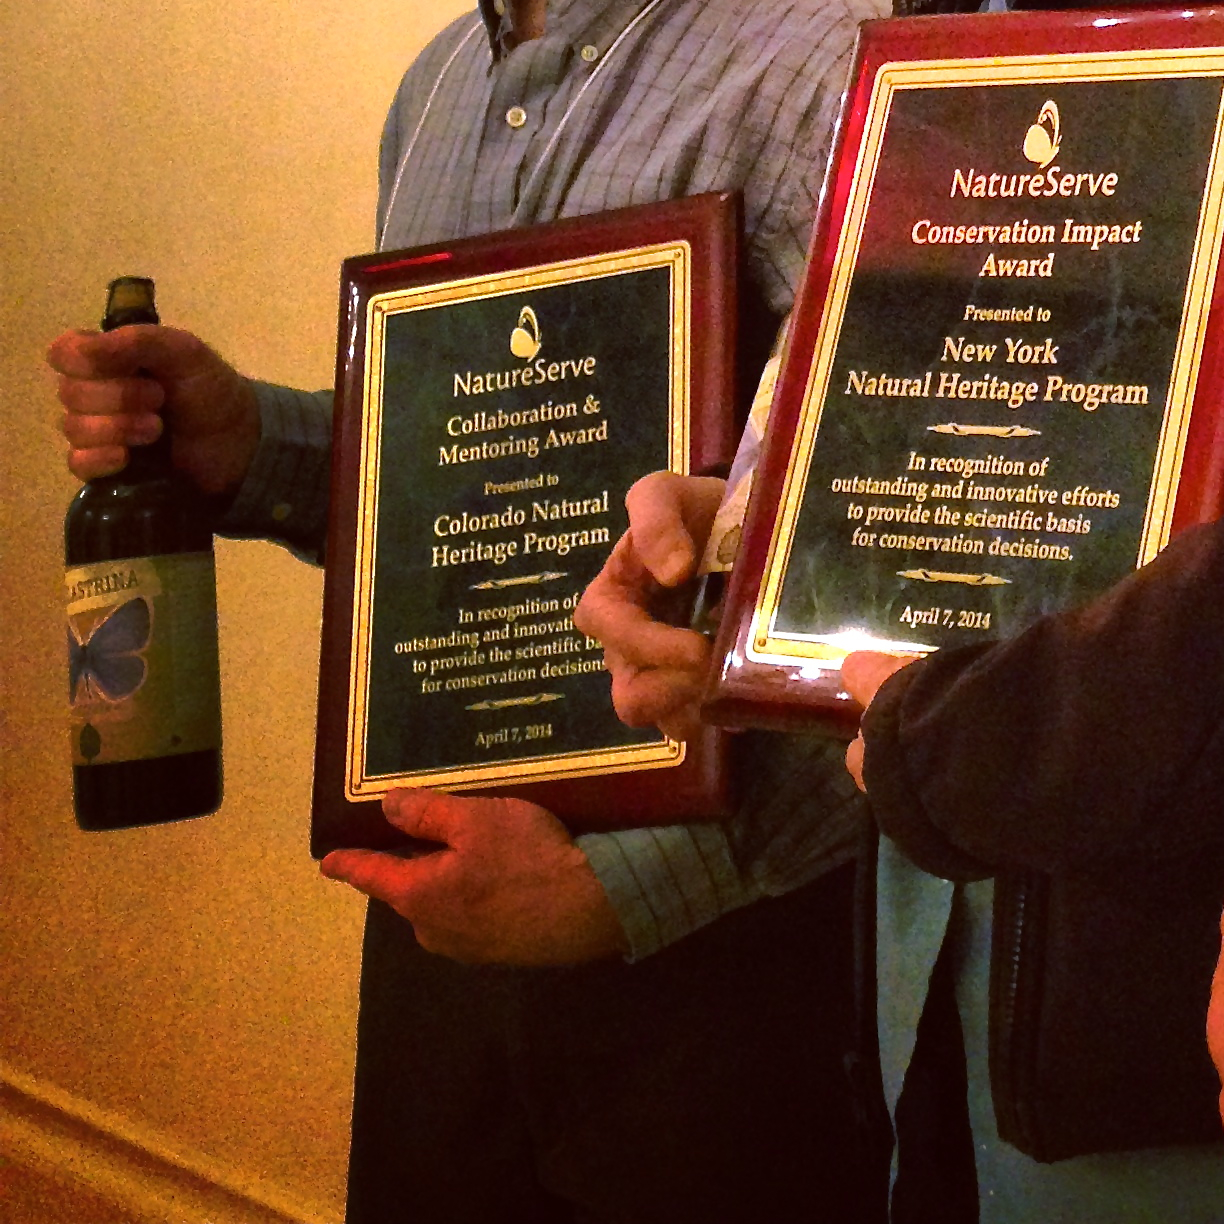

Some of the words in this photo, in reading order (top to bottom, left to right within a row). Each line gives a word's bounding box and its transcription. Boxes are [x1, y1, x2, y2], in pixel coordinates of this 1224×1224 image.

[950, 166, 1118, 198] NatureServe
[911, 219, 1055, 244] Conservation
[1060, 219, 1142, 250] Impact
[979, 253, 1054, 277] Award
[963, 305, 1033, 322] Presented
[1037, 307, 1051, 322] to
[941, 337, 997, 362] New
[1005, 338, 1059, 364] York
[453, 356, 596, 397] NatureServe
[845, 370, 932, 398] Natural
[936, 373, 1038, 408] Heritage
[1043, 376, 1149, 411] Program
[447, 401, 577, 436] Collaboration
[583, 394, 600, 414] &
[438, 435, 539, 466] Mentoring
[544, 420, 608, 449] Award
[908, 451, 925, 471] In
[929, 454, 1025, 478] recognition
[1029, 457, 1049, 476] of
[484, 474, 543, 495] Presented
[547, 474, 559, 486] to
[831, 477, 929, 502] outstanding
[931, 481, 962, 499] and
[966, 481, 1057, 504] innovative
[1062, 486, 1120, 508] efforts
[434, 506, 525, 537] Colorado
[532, 491, 609, 522] Natural
[847, 503, 863, 520] to
[866, 503, 930, 525] provide
[934, 504, 960, 526] the
[964, 509, 1042, 531] scientific
[1046, 512, 1091, 534] basis
[431, 541, 517, 568] Heritage
[523, 527, 610, 555] Program
[851, 528, 876, 547] for
[879, 532, 984, 555] conservation
[988, 537, 1073, 561] decisions.
[458, 609, 473, 623] In
[478, 598, 558, 622] recognition
[563, 593, 578, 609] of
[900, 606, 940, 629] April
[944, 610, 954, 627] 7,
[958, 611, 991, 629] 2014
[395, 631, 479, 654] outstanding
[483, 624, 509, 642] and
[514, 617, 573, 638] innovati
[413, 660, 426, 673] to
[431, 651, 485, 675] provide
[490, 646, 511, 663] the
[515, 638, 581, 660] scientific
[421, 677, 442, 694] for
[446, 668, 536, 690] conservation
[475, 729, 508, 748] April
[511, 728, 522, 743] 7,
[526, 724, 552, 740] 2014
